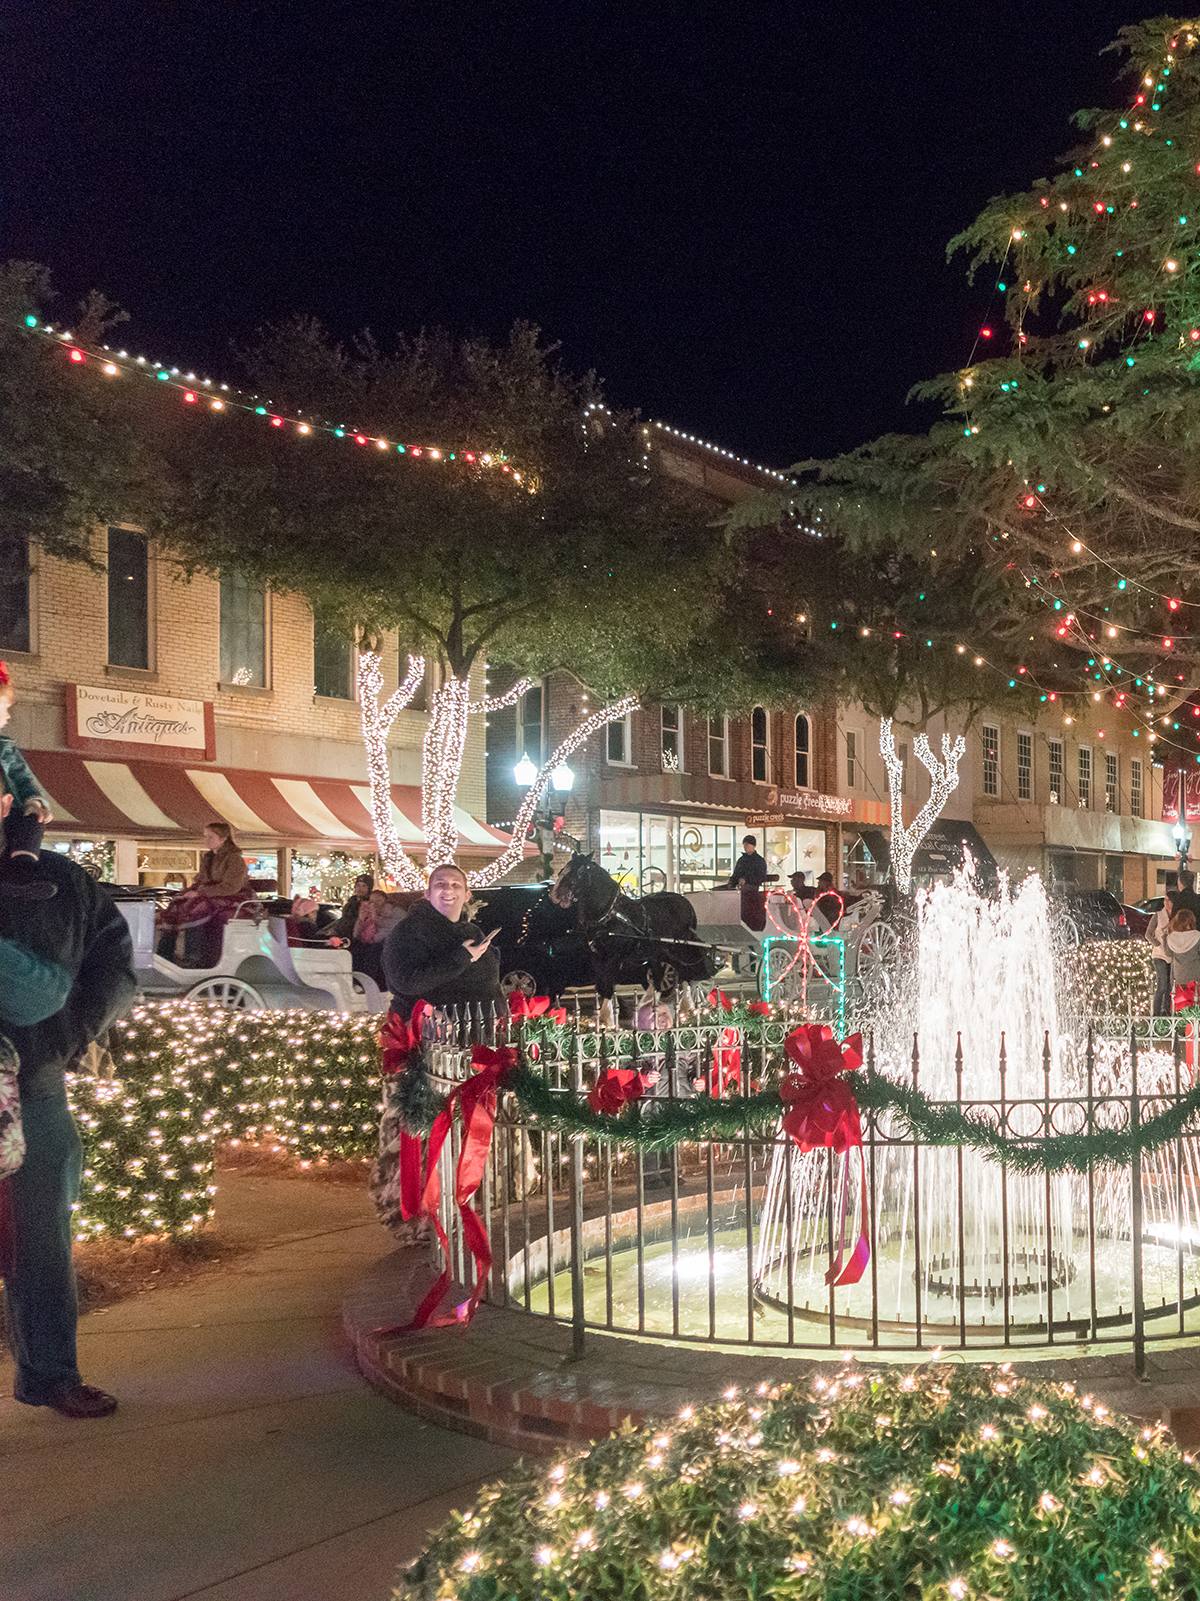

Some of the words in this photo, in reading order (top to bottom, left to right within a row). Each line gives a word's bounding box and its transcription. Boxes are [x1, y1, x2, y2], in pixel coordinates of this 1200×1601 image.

[78, 688, 129, 705] Dovetails
[132, 695, 141, 704] &
[145, 698, 173, 712] Rusty
[177, 701, 203, 714] Nails
[86, 706, 197, 742] Antiques
[780, 793, 802, 810] puzzle
